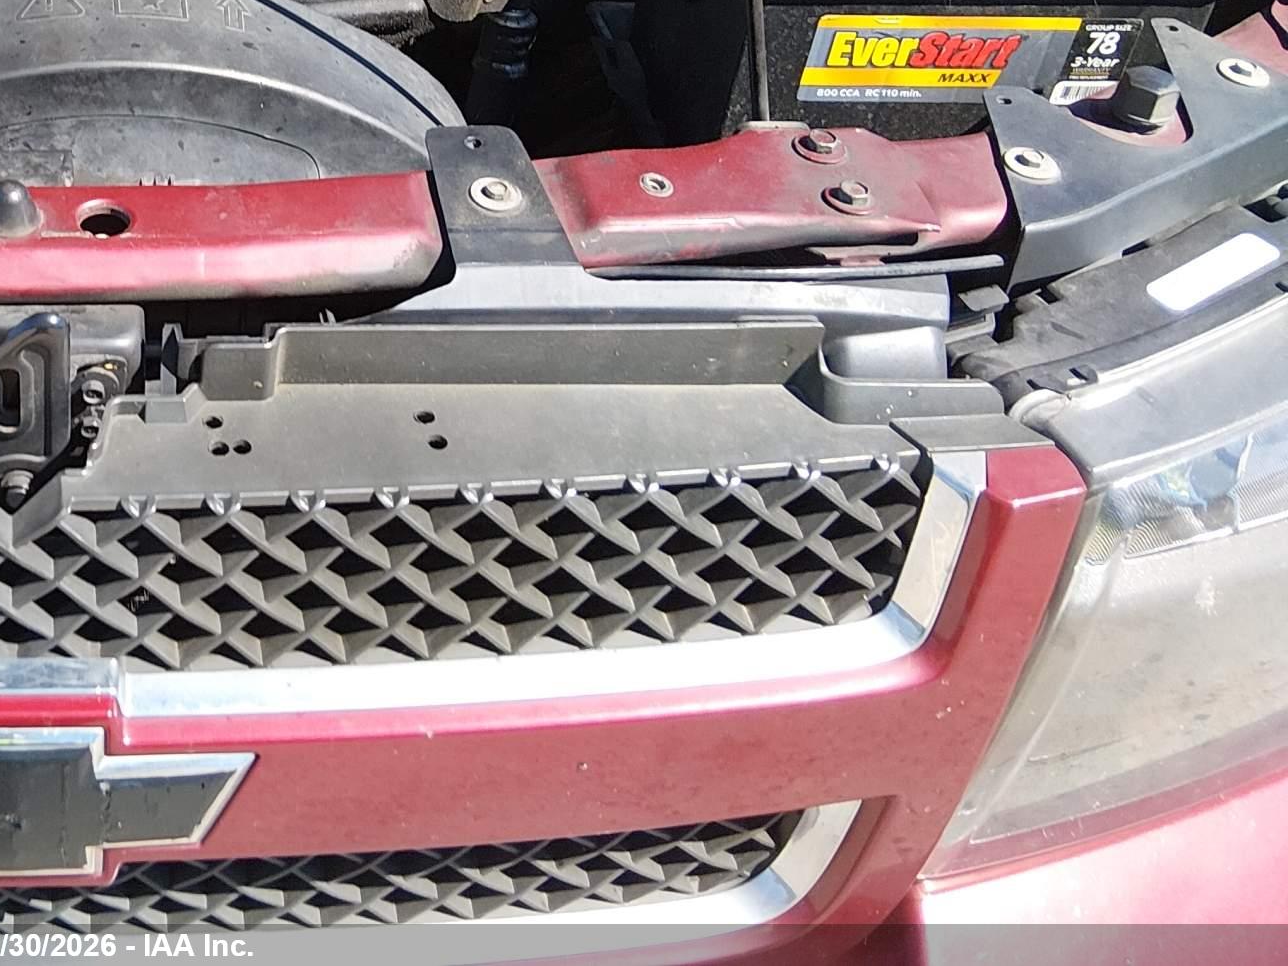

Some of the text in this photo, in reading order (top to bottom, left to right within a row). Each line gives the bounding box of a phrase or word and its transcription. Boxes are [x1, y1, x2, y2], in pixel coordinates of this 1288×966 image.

[1086, 31, 1121, 54] 78
[826, 30, 1022, 68] EverStart
[1070, 56, 1120, 68] 3-Year
[937, 72, 991, 83] MAXX
[816, 88, 922, 98] 800 CCA RC 110 min.
